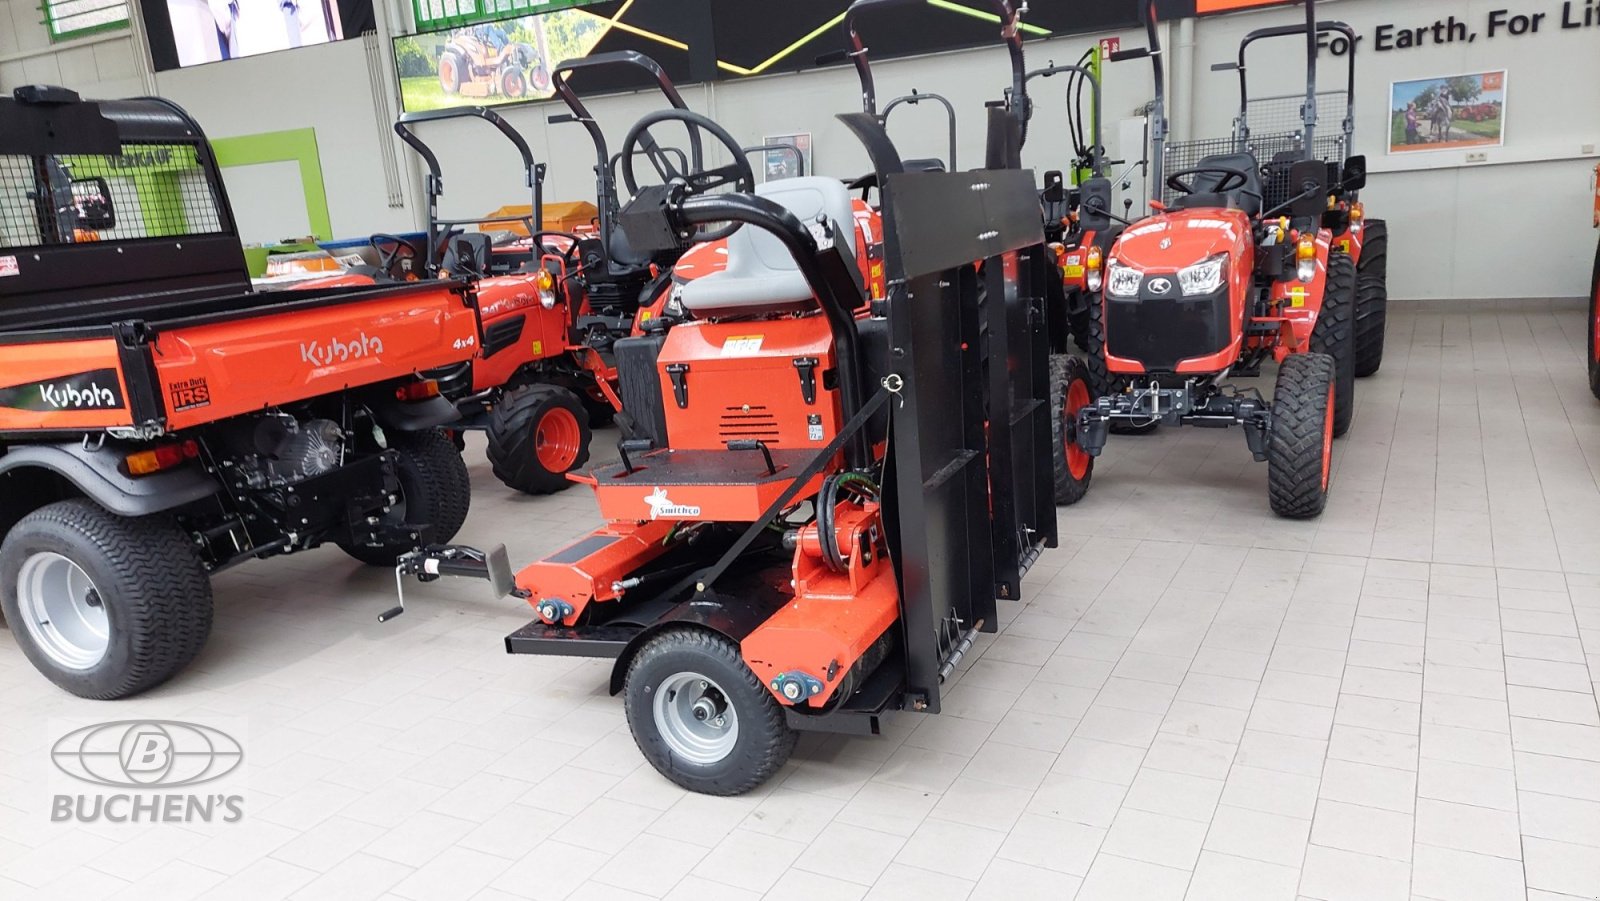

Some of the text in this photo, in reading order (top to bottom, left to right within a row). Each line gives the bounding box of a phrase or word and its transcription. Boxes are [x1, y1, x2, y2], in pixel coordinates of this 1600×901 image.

[1315, 32, 1362, 58] Fo
[1375, 16, 1476, 51] Earth,
[1487, 9, 1545, 37] For
[105, 148, 173, 169] VERKAUF
[300, 331, 383, 367] Kubota
[453, 335, 475, 350] 4x4
[189, 377, 206, 387] Duty
[39, 382, 116, 408] Kubota
[172, 386, 209, 408] IRS
[660, 506, 699, 514] Smithco
